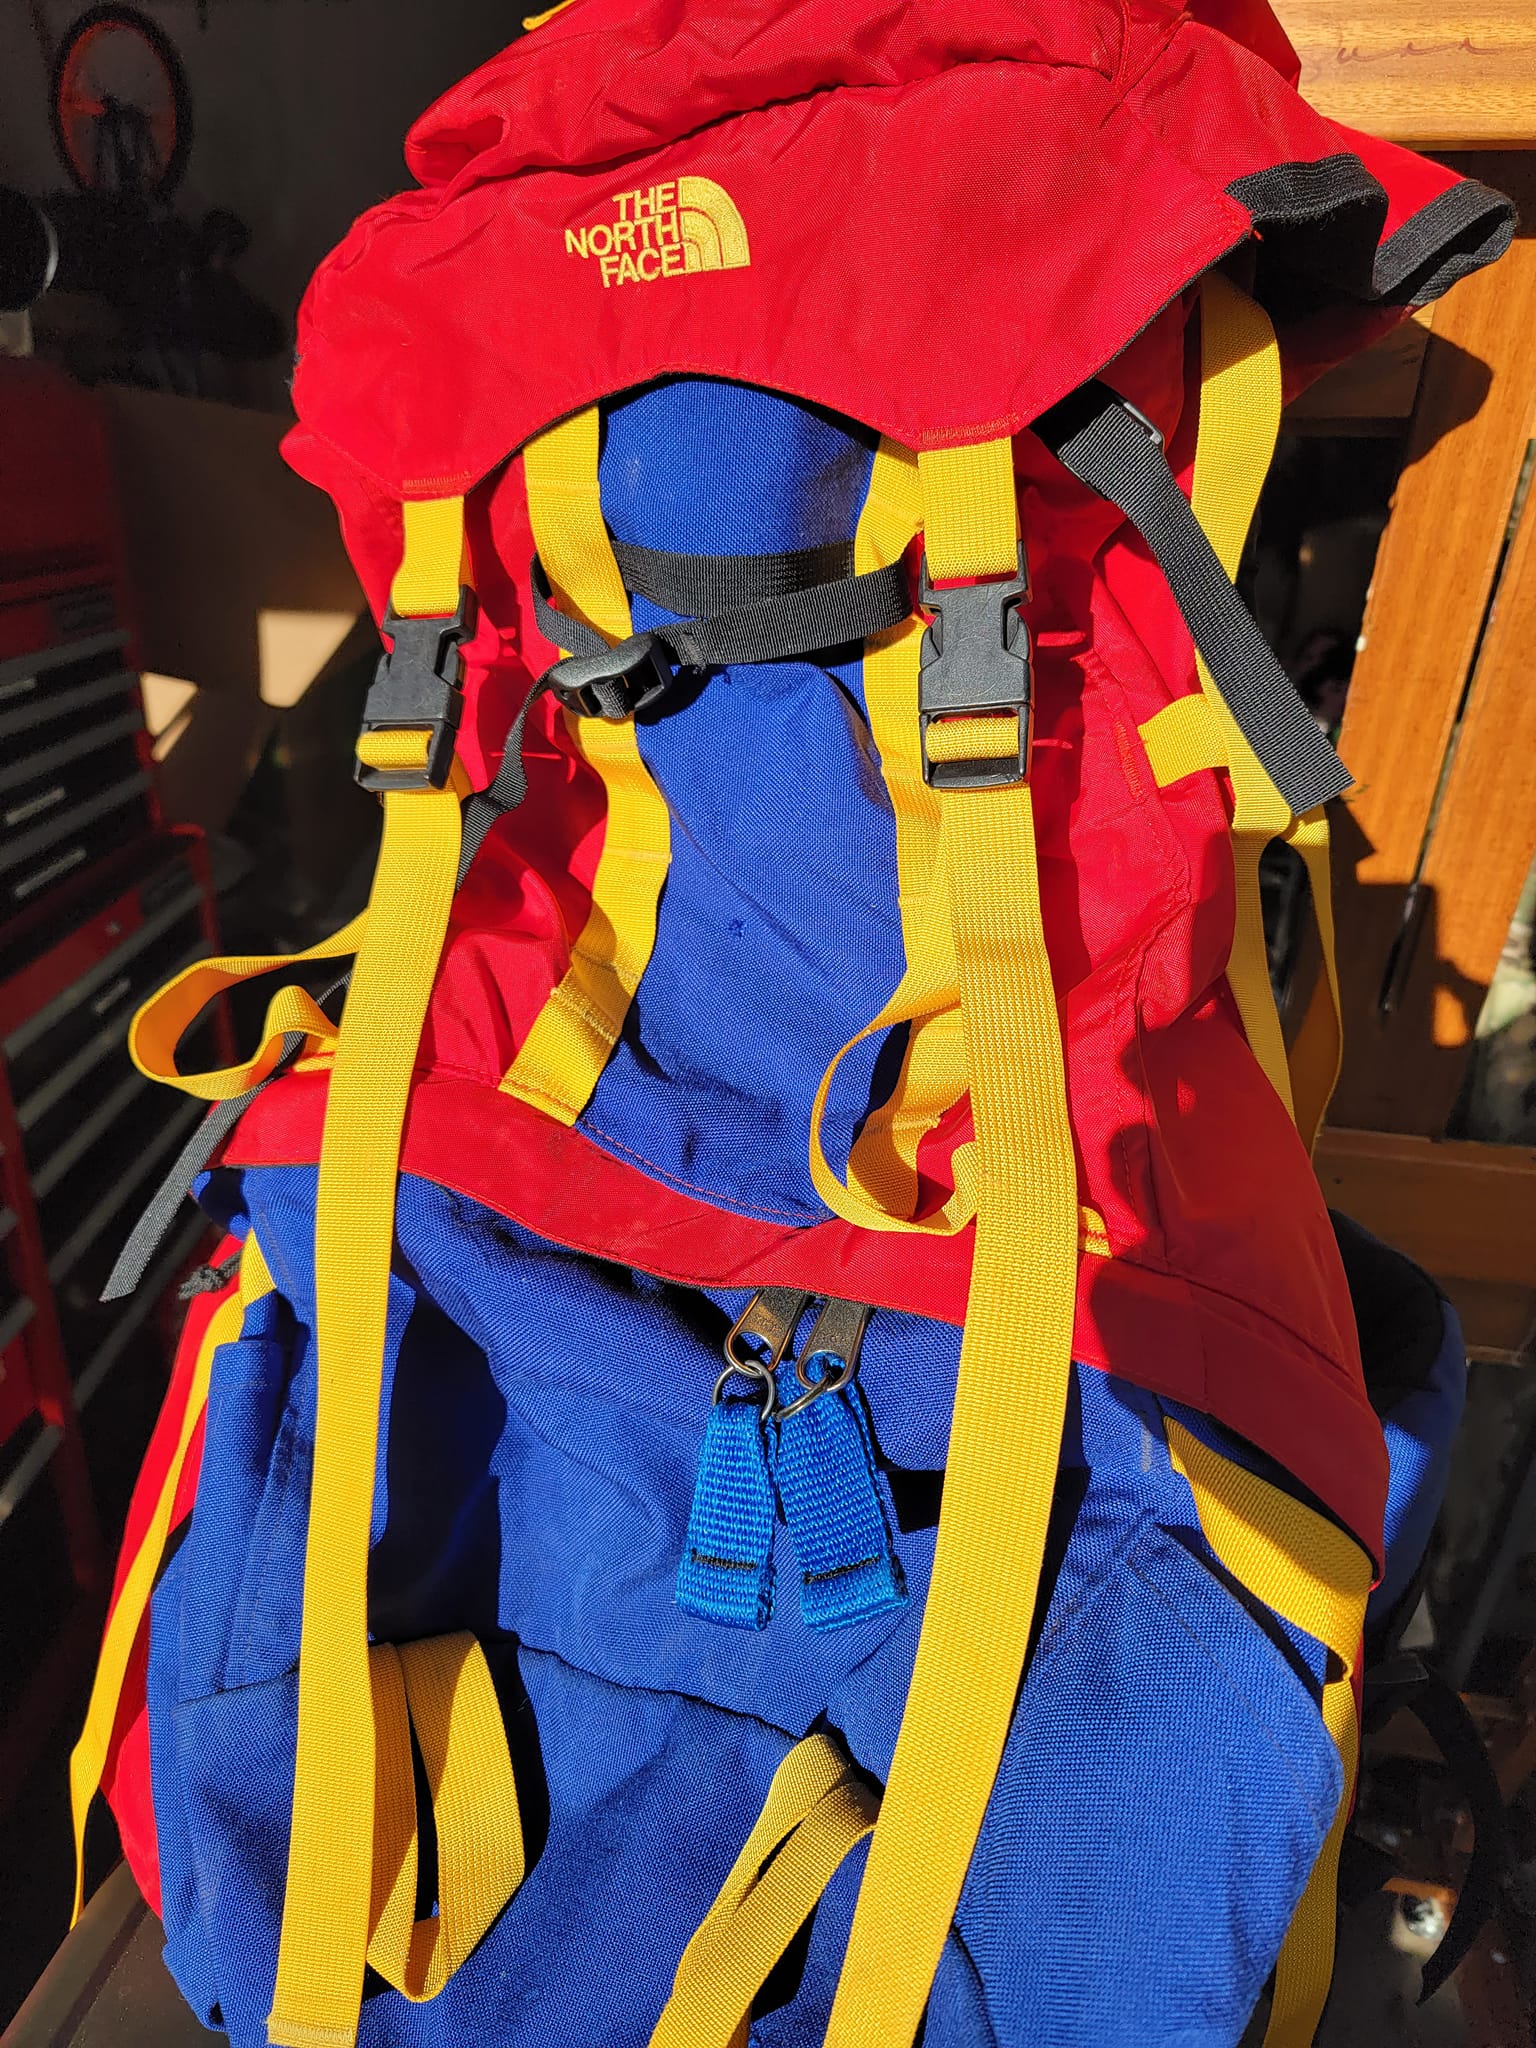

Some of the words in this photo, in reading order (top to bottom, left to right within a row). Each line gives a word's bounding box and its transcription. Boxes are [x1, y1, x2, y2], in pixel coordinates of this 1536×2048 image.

[612, 181, 677, 221] THE
[564, 206, 680, 259] NORTH
[600, 243, 685, 288] FACE
